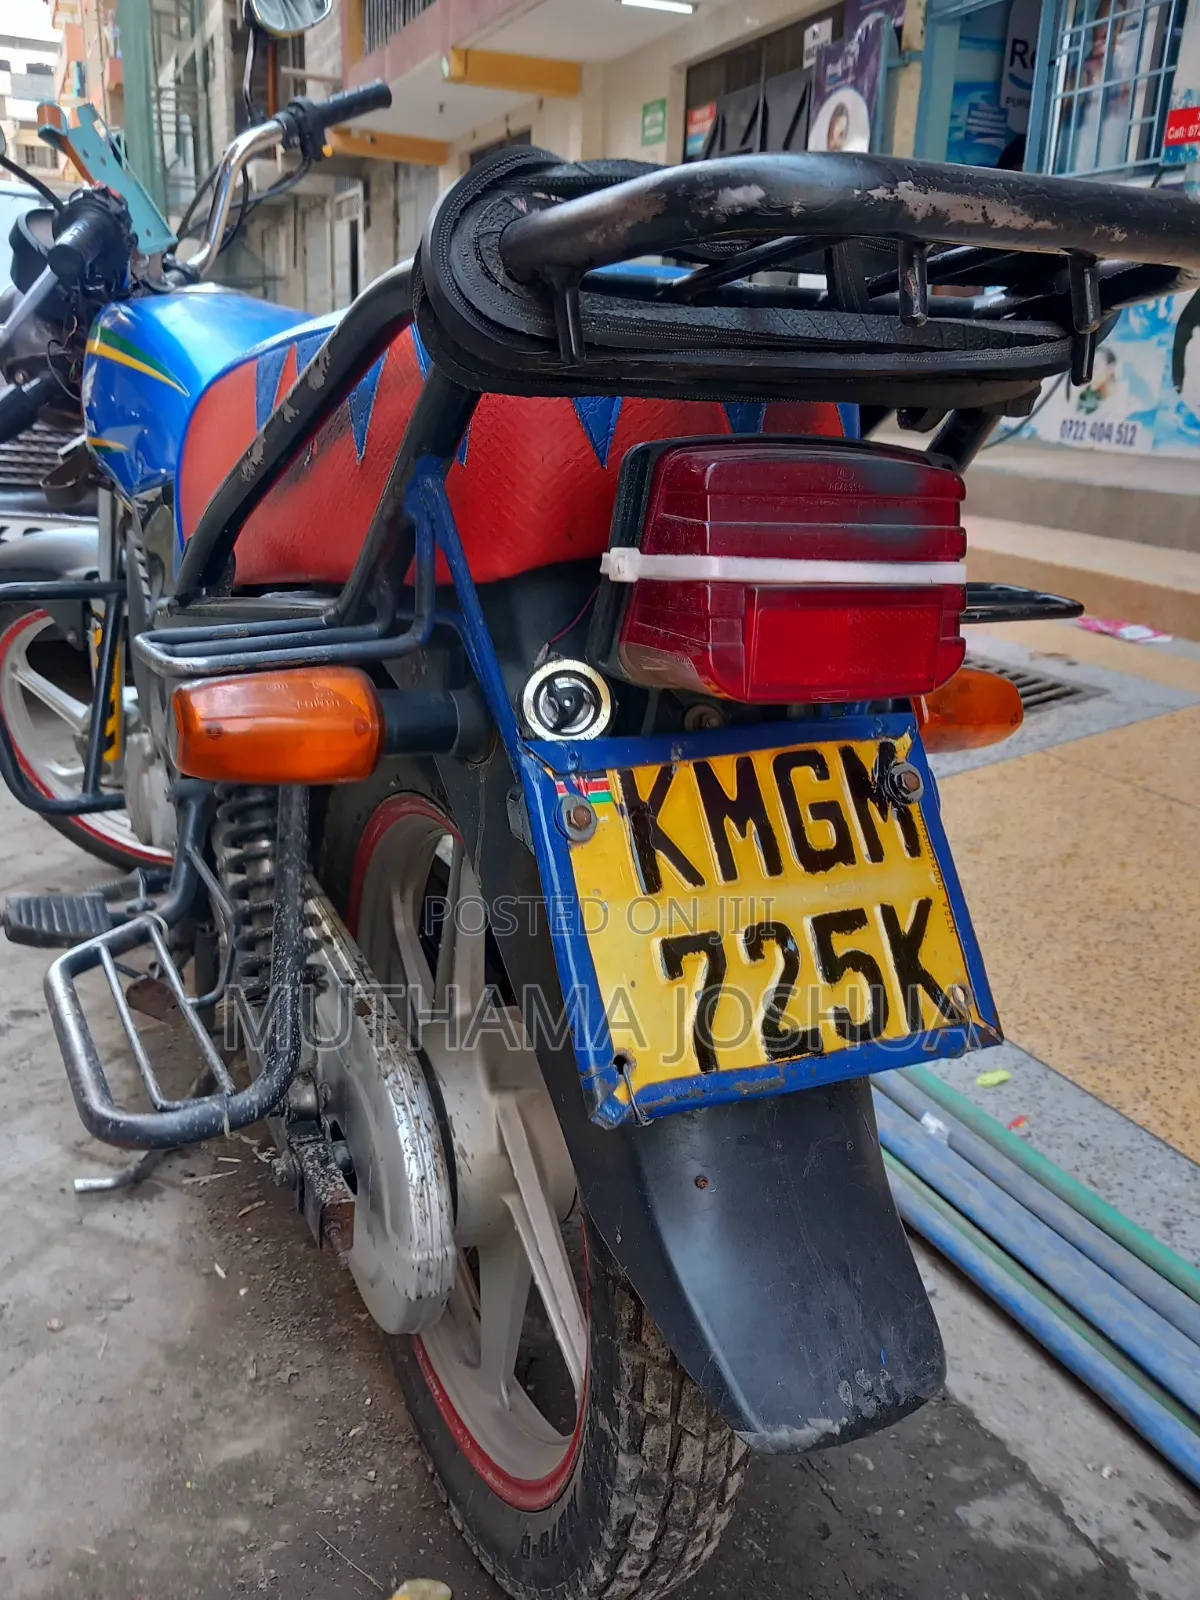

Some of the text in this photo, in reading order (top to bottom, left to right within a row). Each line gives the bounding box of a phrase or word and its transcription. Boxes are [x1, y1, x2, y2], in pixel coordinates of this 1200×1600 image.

[1060, 419, 1137, 447] 0722 404 512
[617, 740, 922, 895] KMGM
[653, 897, 964, 1073] 725K
